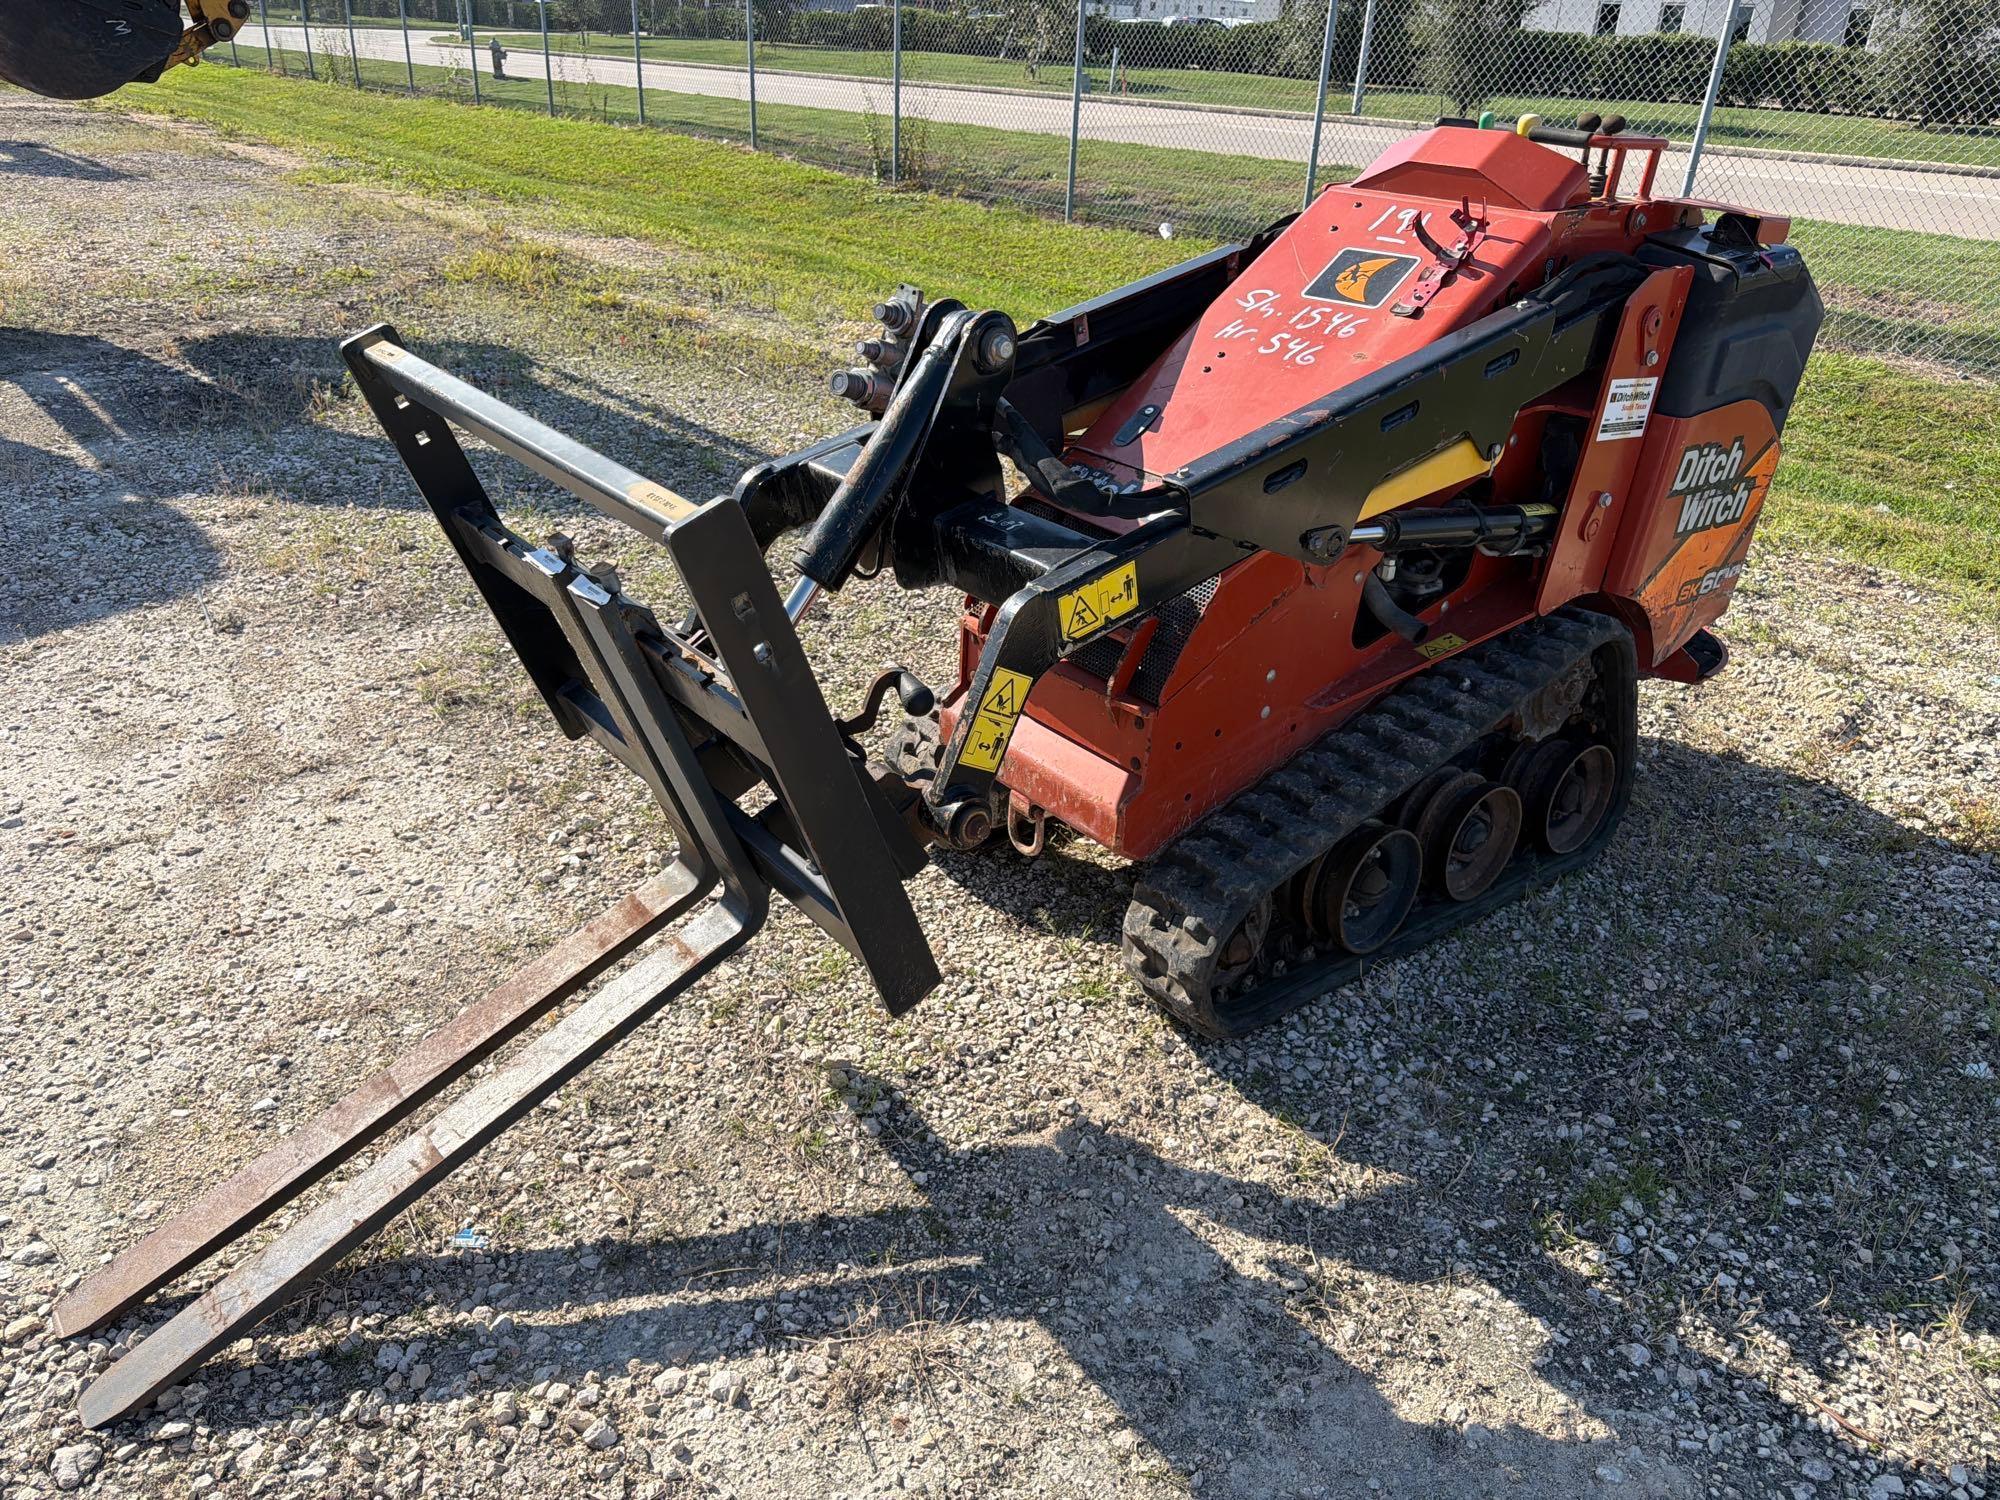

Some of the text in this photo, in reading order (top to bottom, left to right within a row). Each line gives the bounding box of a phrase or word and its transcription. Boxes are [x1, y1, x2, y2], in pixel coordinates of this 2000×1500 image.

[105, 19, 133, 37] 3
[1213, 319, 1326, 366] Hr. 546
[1288, 306, 1370, 339] 1546
[1617, 390, 1651, 402] Ditch Witch
[1672, 440, 1744, 491] Ditch
[1677, 482, 1749, 533] Witch
